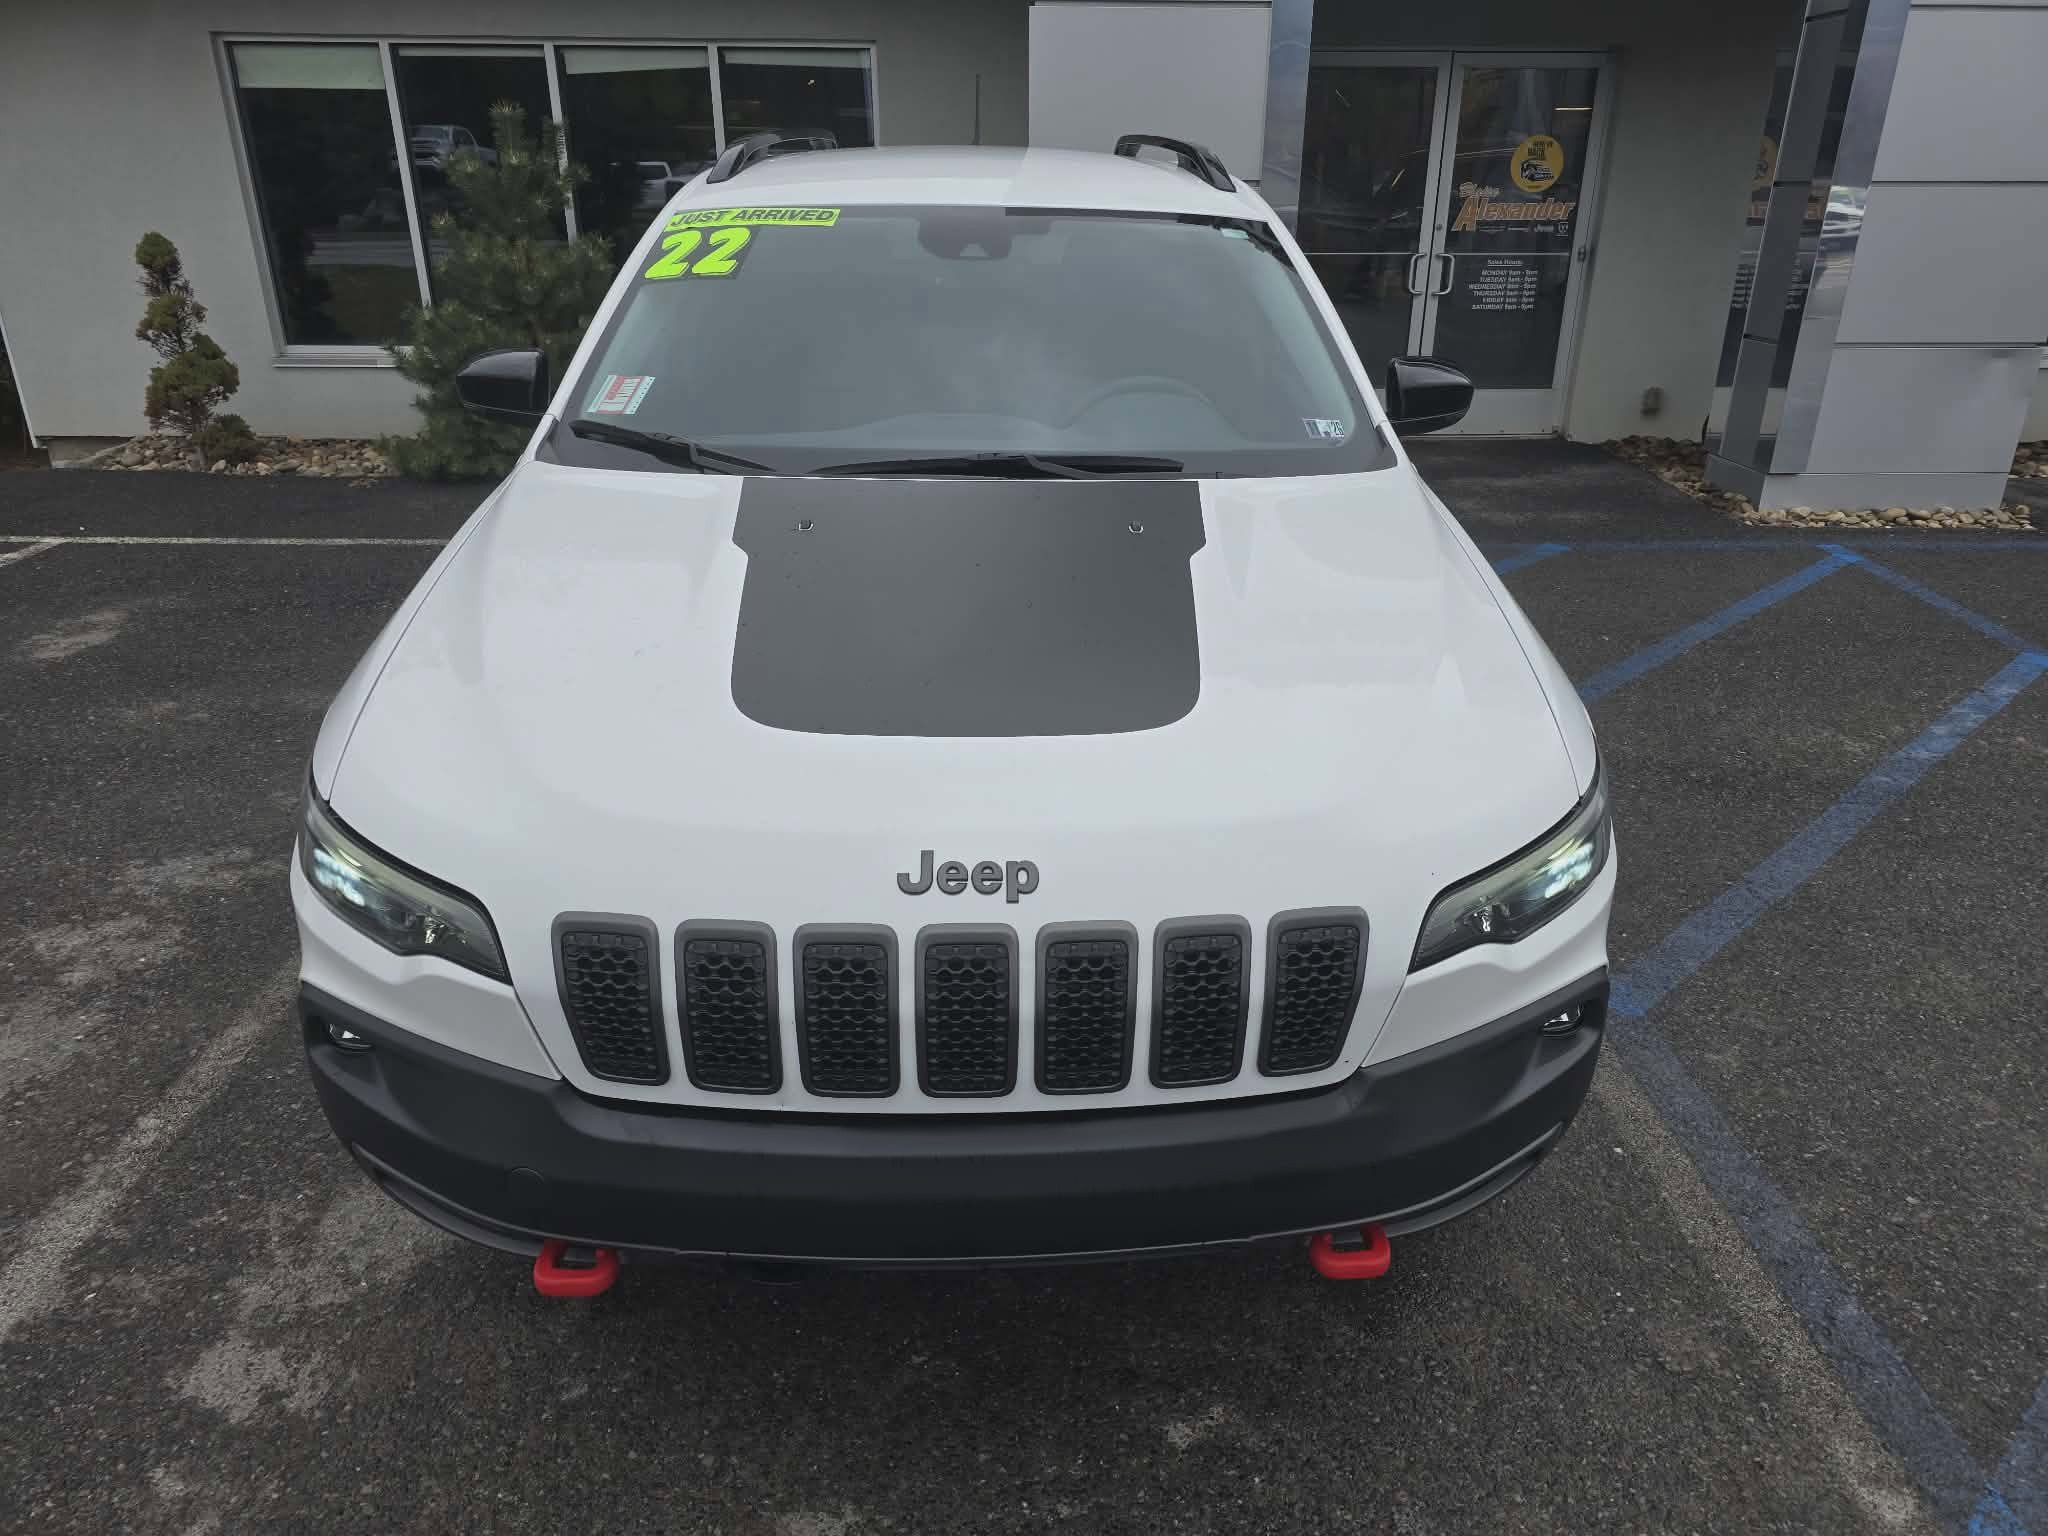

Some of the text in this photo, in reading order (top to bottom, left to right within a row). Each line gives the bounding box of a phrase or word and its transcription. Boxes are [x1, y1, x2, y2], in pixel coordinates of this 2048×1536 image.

[672, 208, 835, 225] JUST ARRIVED
[1451, 196, 1576, 232] Alexander
[644, 227, 752, 280] 22
[896, 849, 1040, 904] Jeep
